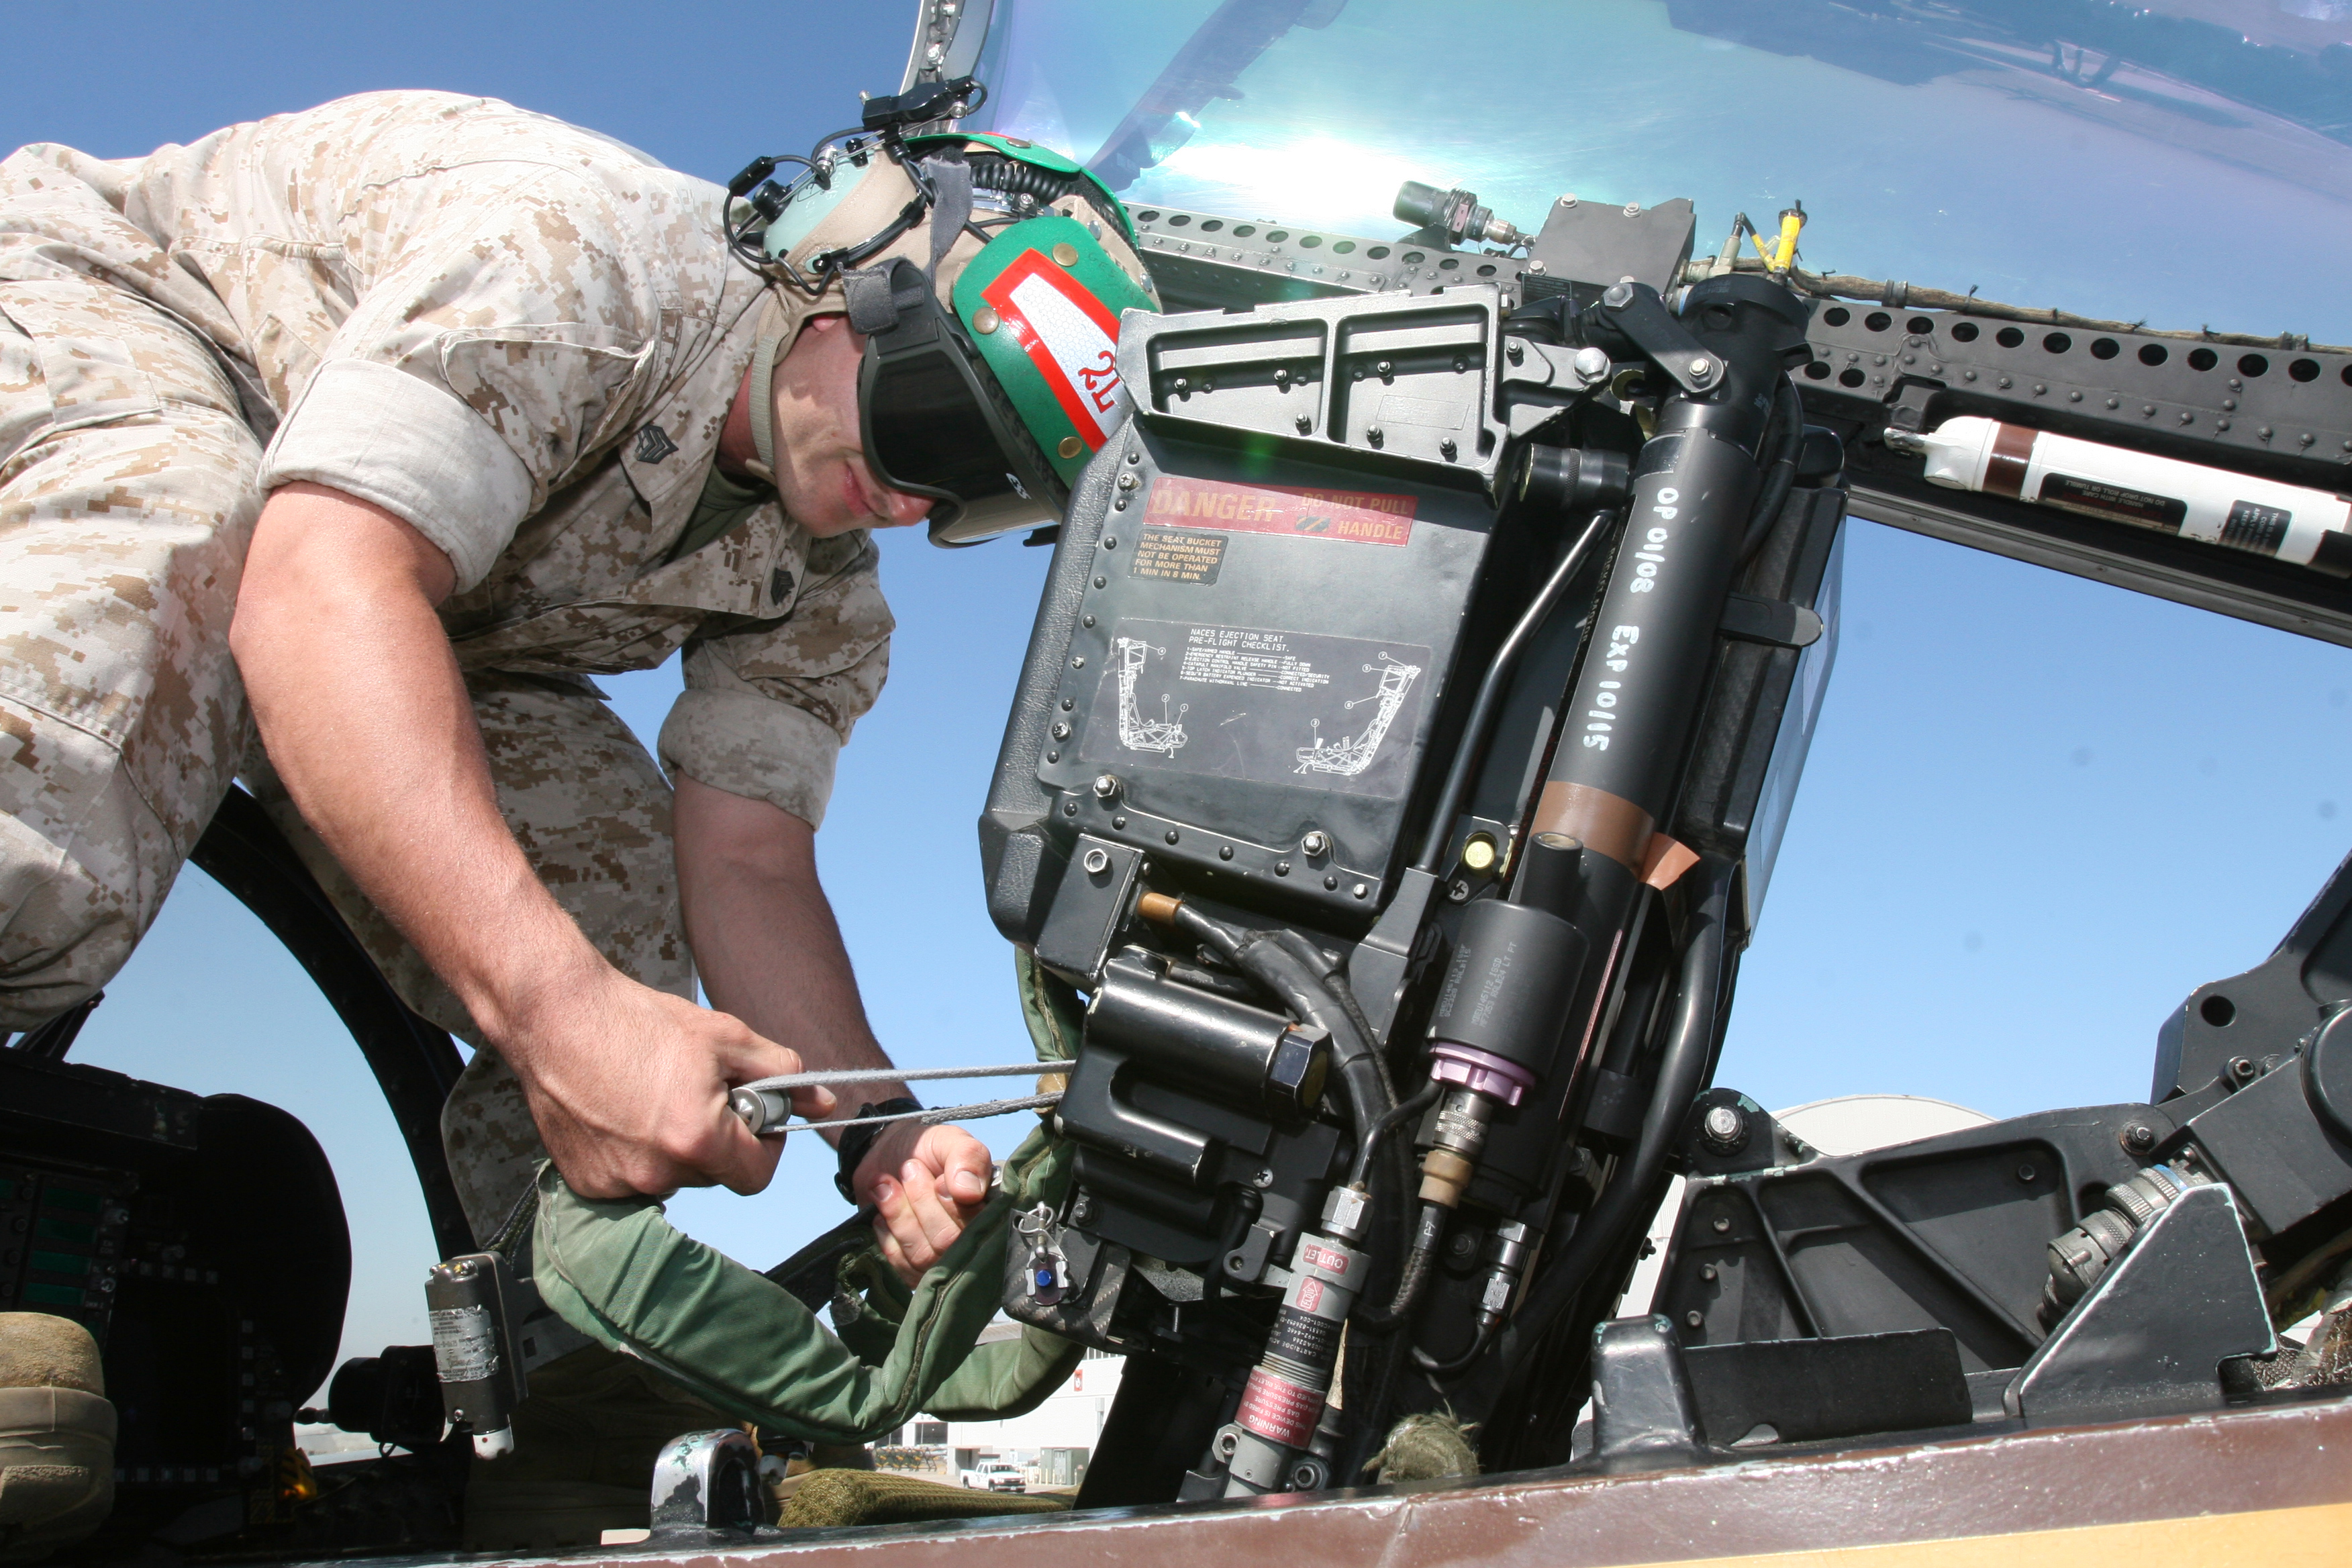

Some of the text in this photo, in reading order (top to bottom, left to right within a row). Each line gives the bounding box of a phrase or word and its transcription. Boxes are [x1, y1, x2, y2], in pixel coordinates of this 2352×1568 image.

[1152, 489, 1277, 522] DANGER
[1302, 493, 1408, 515] DO NOT PULL
[1653, 487, 1679, 520] OP
[1338, 520, 1404, 540] HANDLE
[1143, 533, 1222, 547] THE SEAT BUCKET
[1140, 542, 1221, 556] MECHANISM MUST
[1138, 550, 1218, 564] NOT BE OPERATED
[1135, 558, 1208, 572] FOR MORE THAN
[1140, 568, 1159, 576] MIN
[1181, 572, 1201, 580] MIN.
[1190, 628, 1216, 637] NACES
[1219, 630, 1259, 640] EJECTION
[1189, 636, 1289, 652] PRE-FLIGHT CHECKLIST.
[1606, 625, 1640, 672] EXP
[1422, 1220, 1437, 1237] P-7
[1304, 1247, 1344, 1269] OUTLET
[1281, 1340, 1317, 1358] CARTRIDGE
[1272, 1383, 1287, 1393] THE
[1286, 1389, 1296, 1397] TO
[1261, 1388, 1295, 1406] PRESSURE
[1247, 1402, 1265, 1414] FIRED
[1263, 1409, 1271, 1417] IS
[1285, 1408, 1301, 1418] GAS
[1294, 1401, 1308, 1411] GAS
[1246, 1413, 1291, 1437] WARNING
[1270, 1412, 1295, 1426] DEVICE
